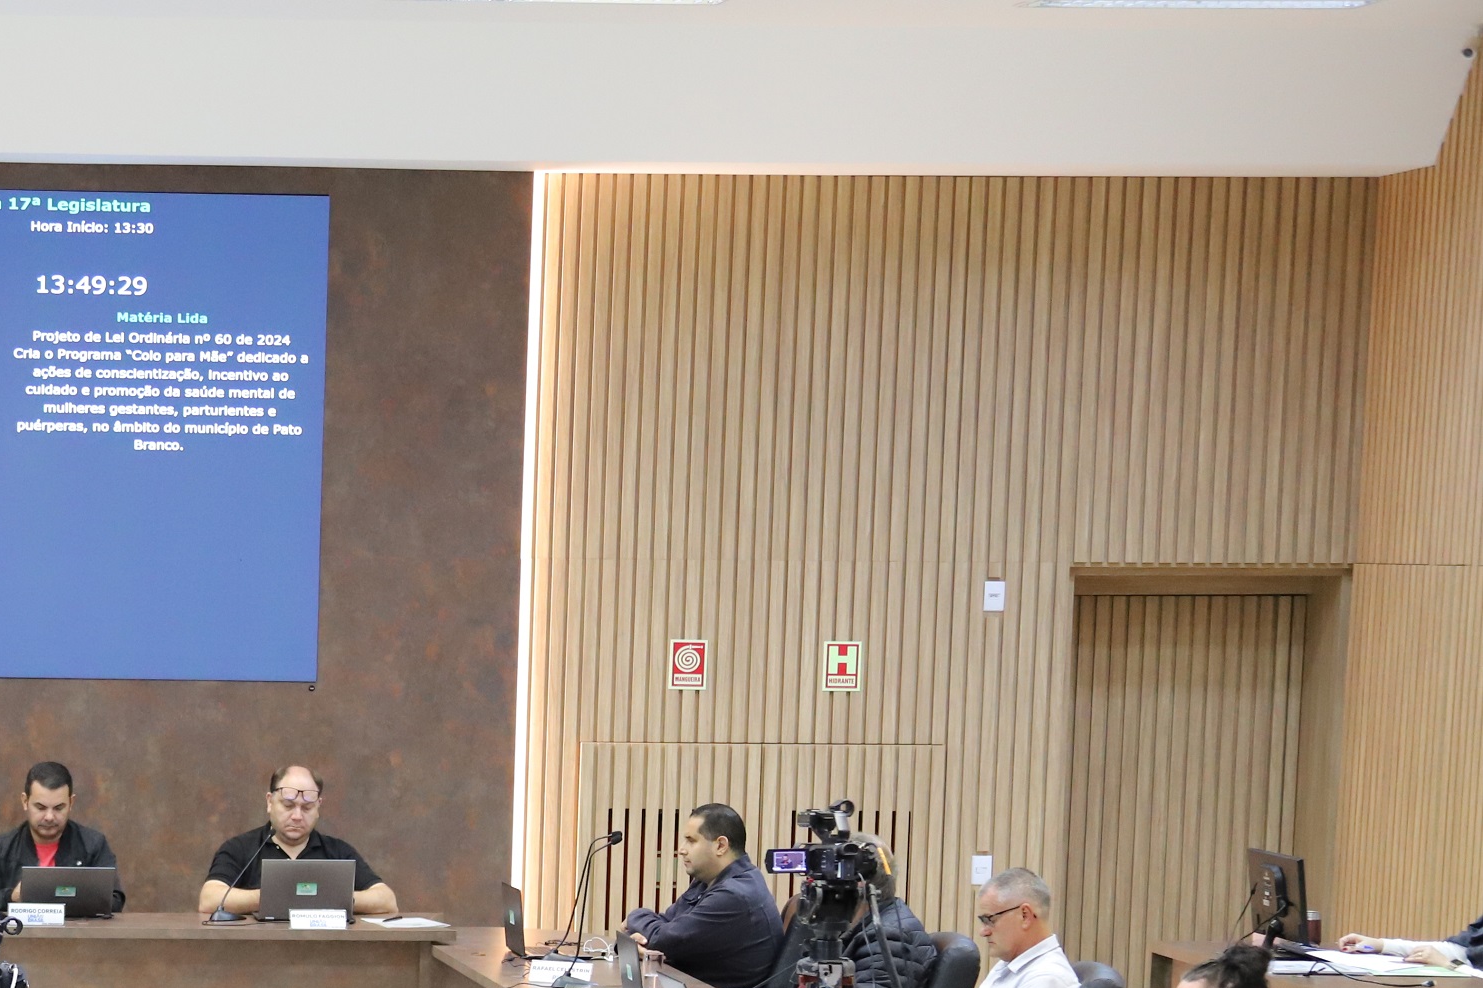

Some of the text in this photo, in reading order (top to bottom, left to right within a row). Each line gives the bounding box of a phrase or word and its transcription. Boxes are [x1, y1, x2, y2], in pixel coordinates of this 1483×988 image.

[8, 196, 41, 211] 17ª
[47, 197, 151, 215] Legislatura
[30, 219, 155, 235] Hora Início: 13:30
[36, 273, 148, 296] 13:49:29
[116, 311, 208, 324] Matéria Lida
[32, 329, 81, 345] Projeto
[83, 330, 102, 343] de
[104, 331, 125, 344] Lei
[127, 331, 191, 345] Ordinária
[214, 333, 233, 346] 60
[235, 333, 254, 346] de
[256, 333, 292, 347] 2024
[12, 347, 41, 360] Cria
[43, 349, 54, 360] o
[57, 347, 122, 363] Programa
[165, 351, 196, 364] para
[236, 350, 297, 364] dedicado
[299, 353, 310, 365] a
[32, 365, 290, 383] ações de conscientização, incentivo ao
[24, 383, 296, 400] cuidado e promoção da saúde mental de
[43, 401, 277, 418] mulheres gestantes, parturientes e
[16, 418, 303, 437] puérperas, no âmbito do município de Pato
[133, 438, 184, 452] Branco.
[828, 677, 855, 685] HIDRANTE
